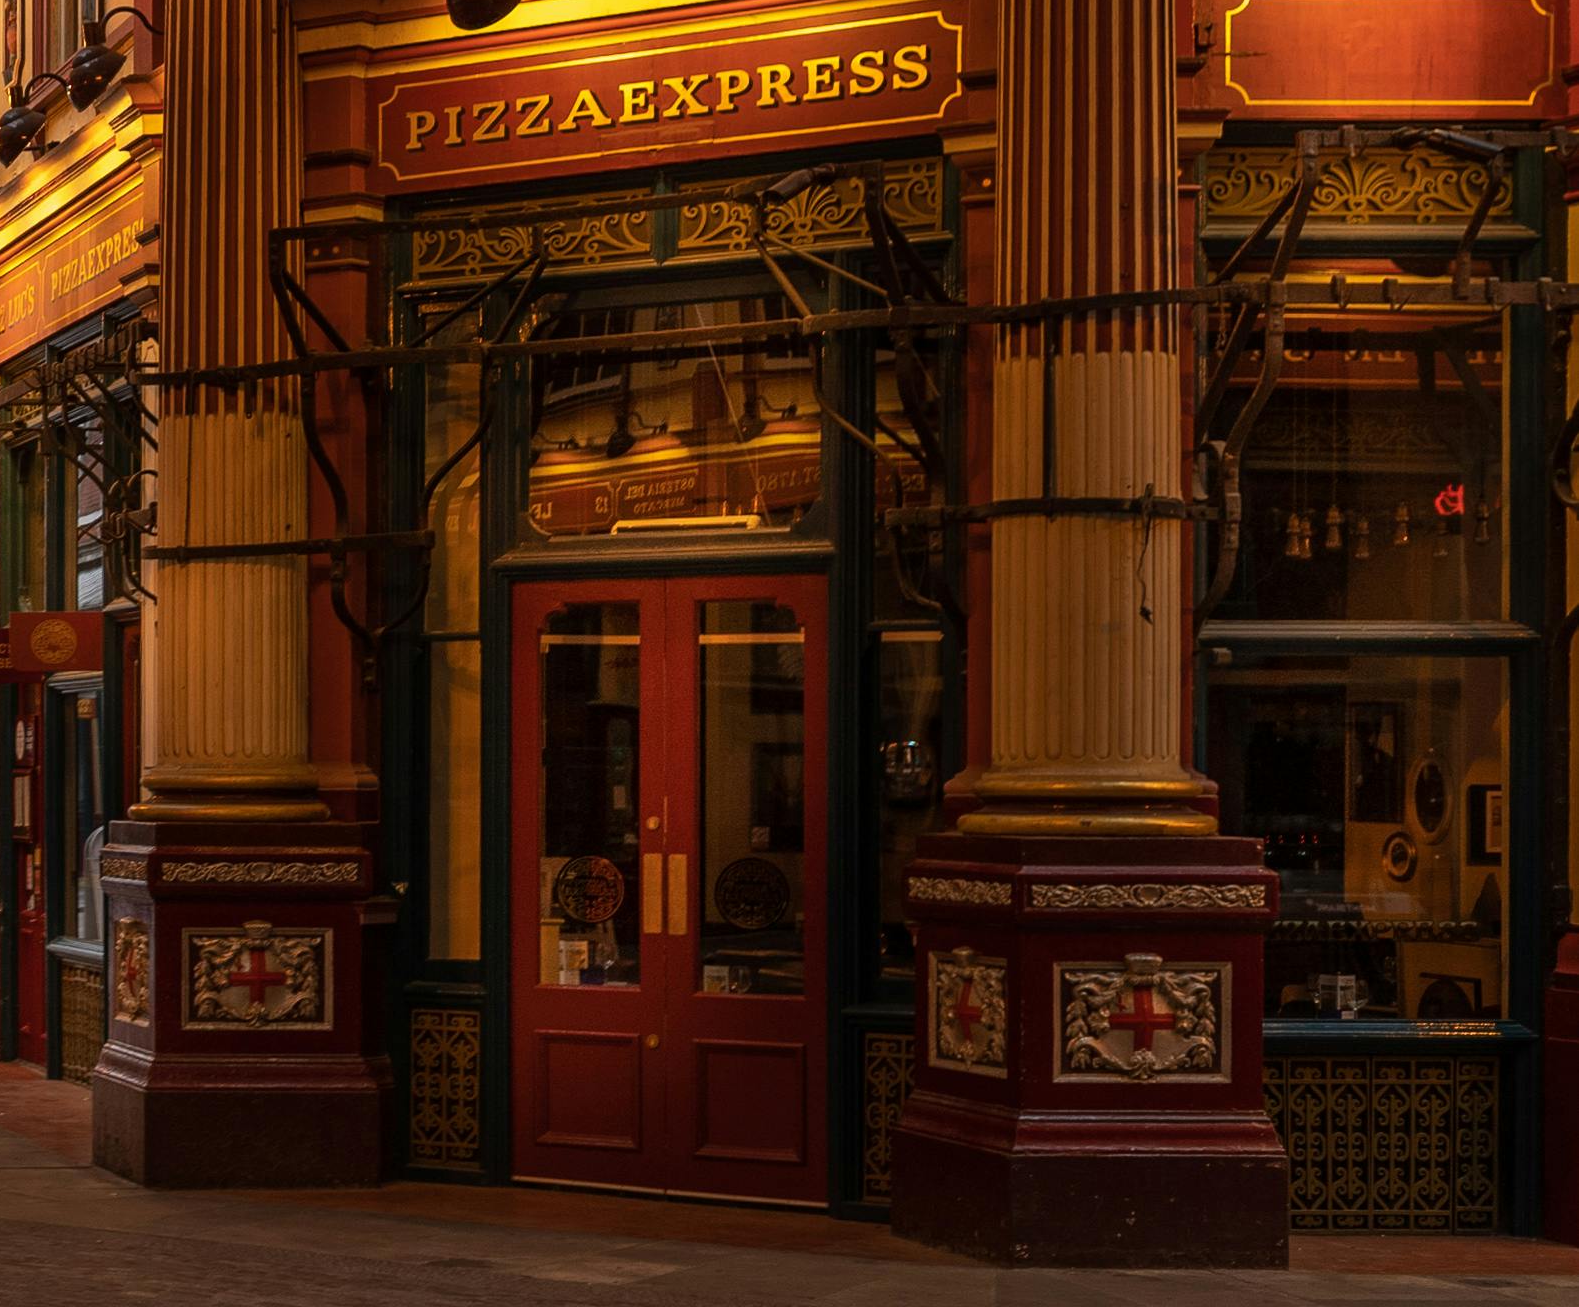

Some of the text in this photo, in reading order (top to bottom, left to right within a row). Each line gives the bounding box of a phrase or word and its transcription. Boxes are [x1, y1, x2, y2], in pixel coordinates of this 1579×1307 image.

[405, 43, 933, 151] PIZZAEXPRESS
[50, 218, 144, 302] PIZZAEXPRES
[8, 284, 35, 327] LUC'S
